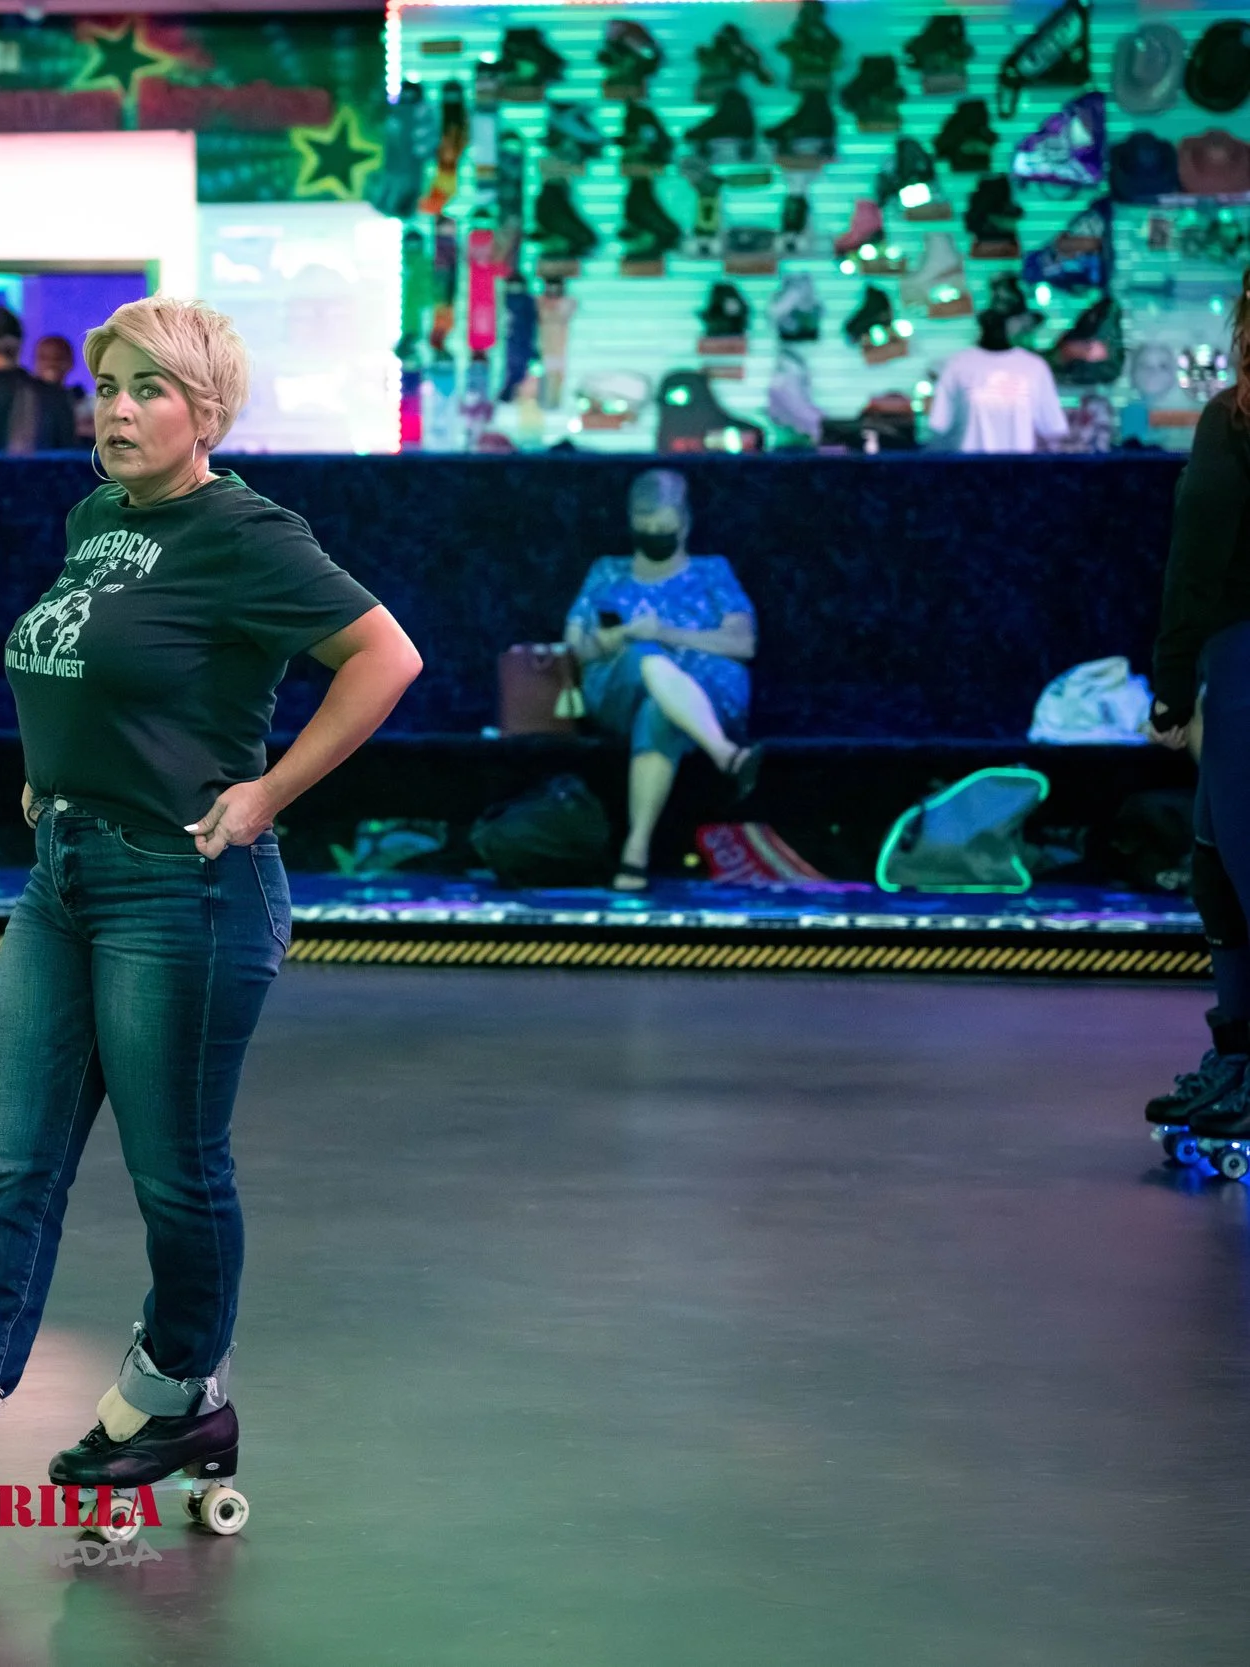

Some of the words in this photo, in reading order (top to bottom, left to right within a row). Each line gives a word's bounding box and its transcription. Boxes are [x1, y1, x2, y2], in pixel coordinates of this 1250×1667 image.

[5, 648, 29, 674] WILD,
[29, 654, 54, 676] WILD
[55, 658, 85, 679] WEST
